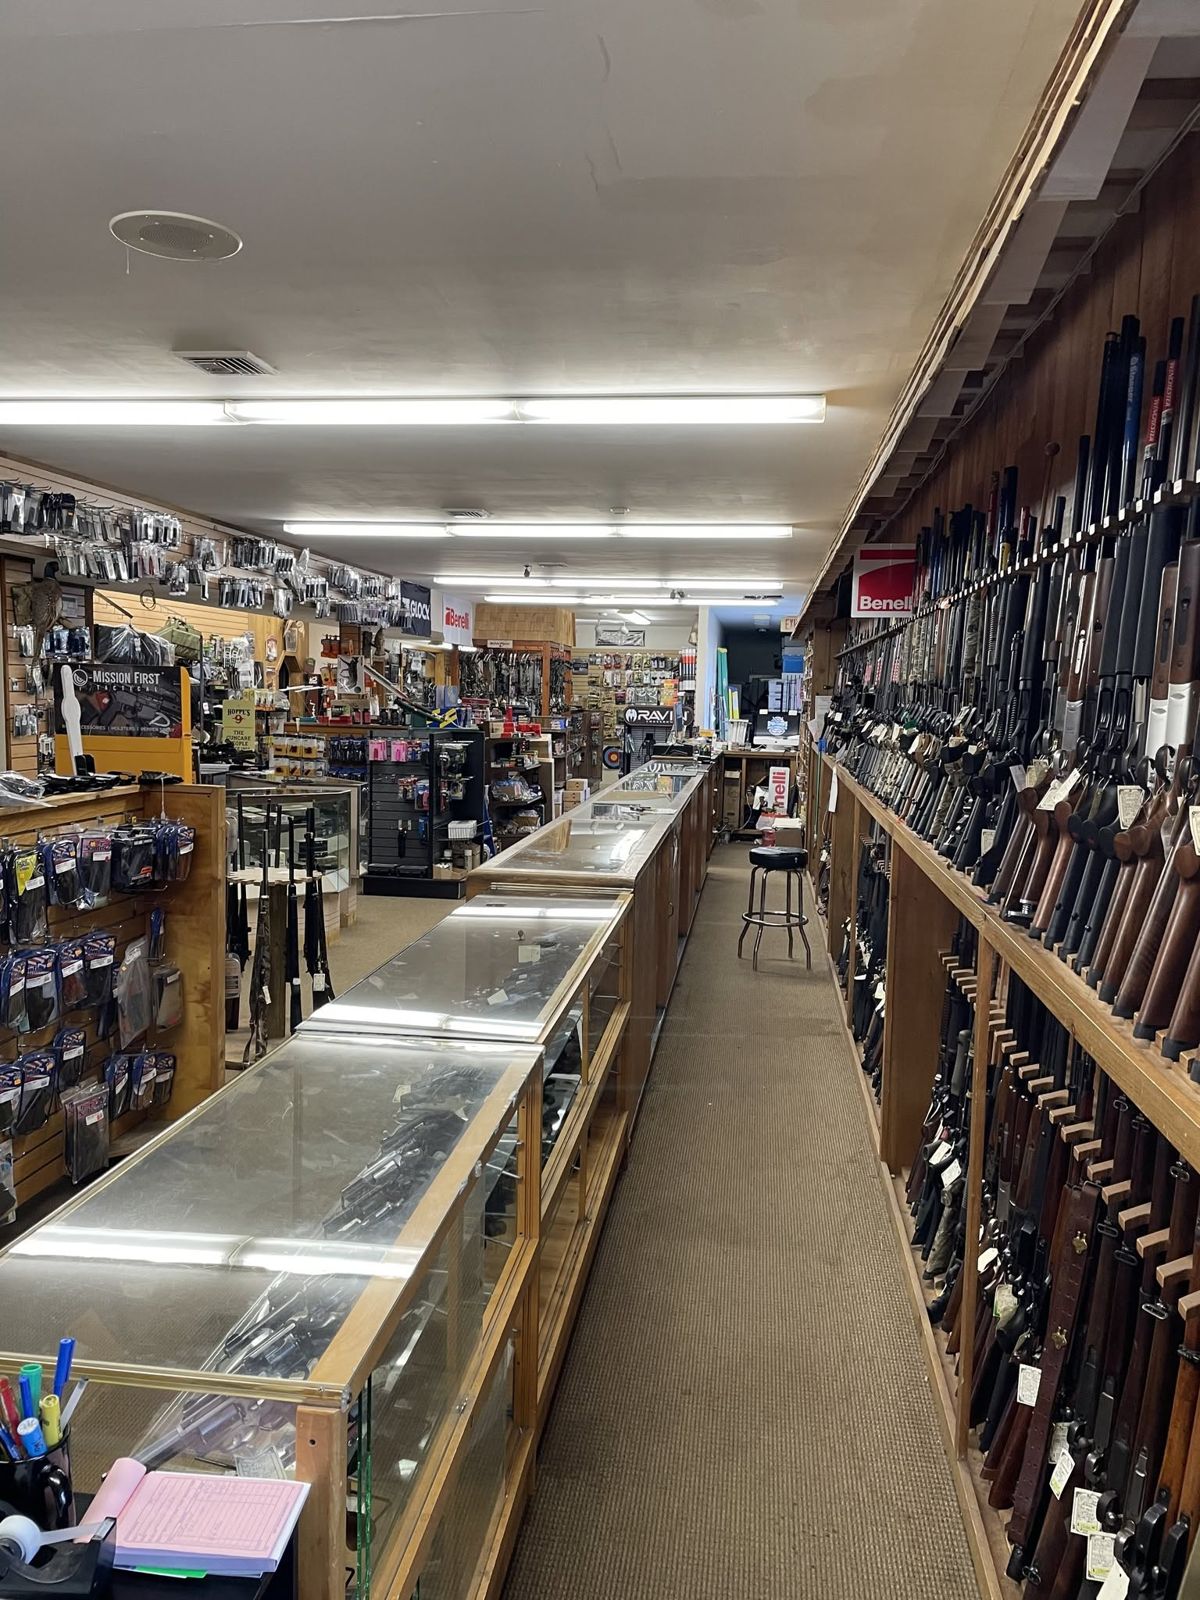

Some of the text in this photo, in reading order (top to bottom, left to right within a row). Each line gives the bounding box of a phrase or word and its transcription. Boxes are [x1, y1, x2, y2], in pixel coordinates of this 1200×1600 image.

[410, 600, 431, 620] GLOCK
[859, 596, 912, 610] Benell
[93, 670, 160, 684] MISSION FIRST
[772, 771, 786, 808] nelli
